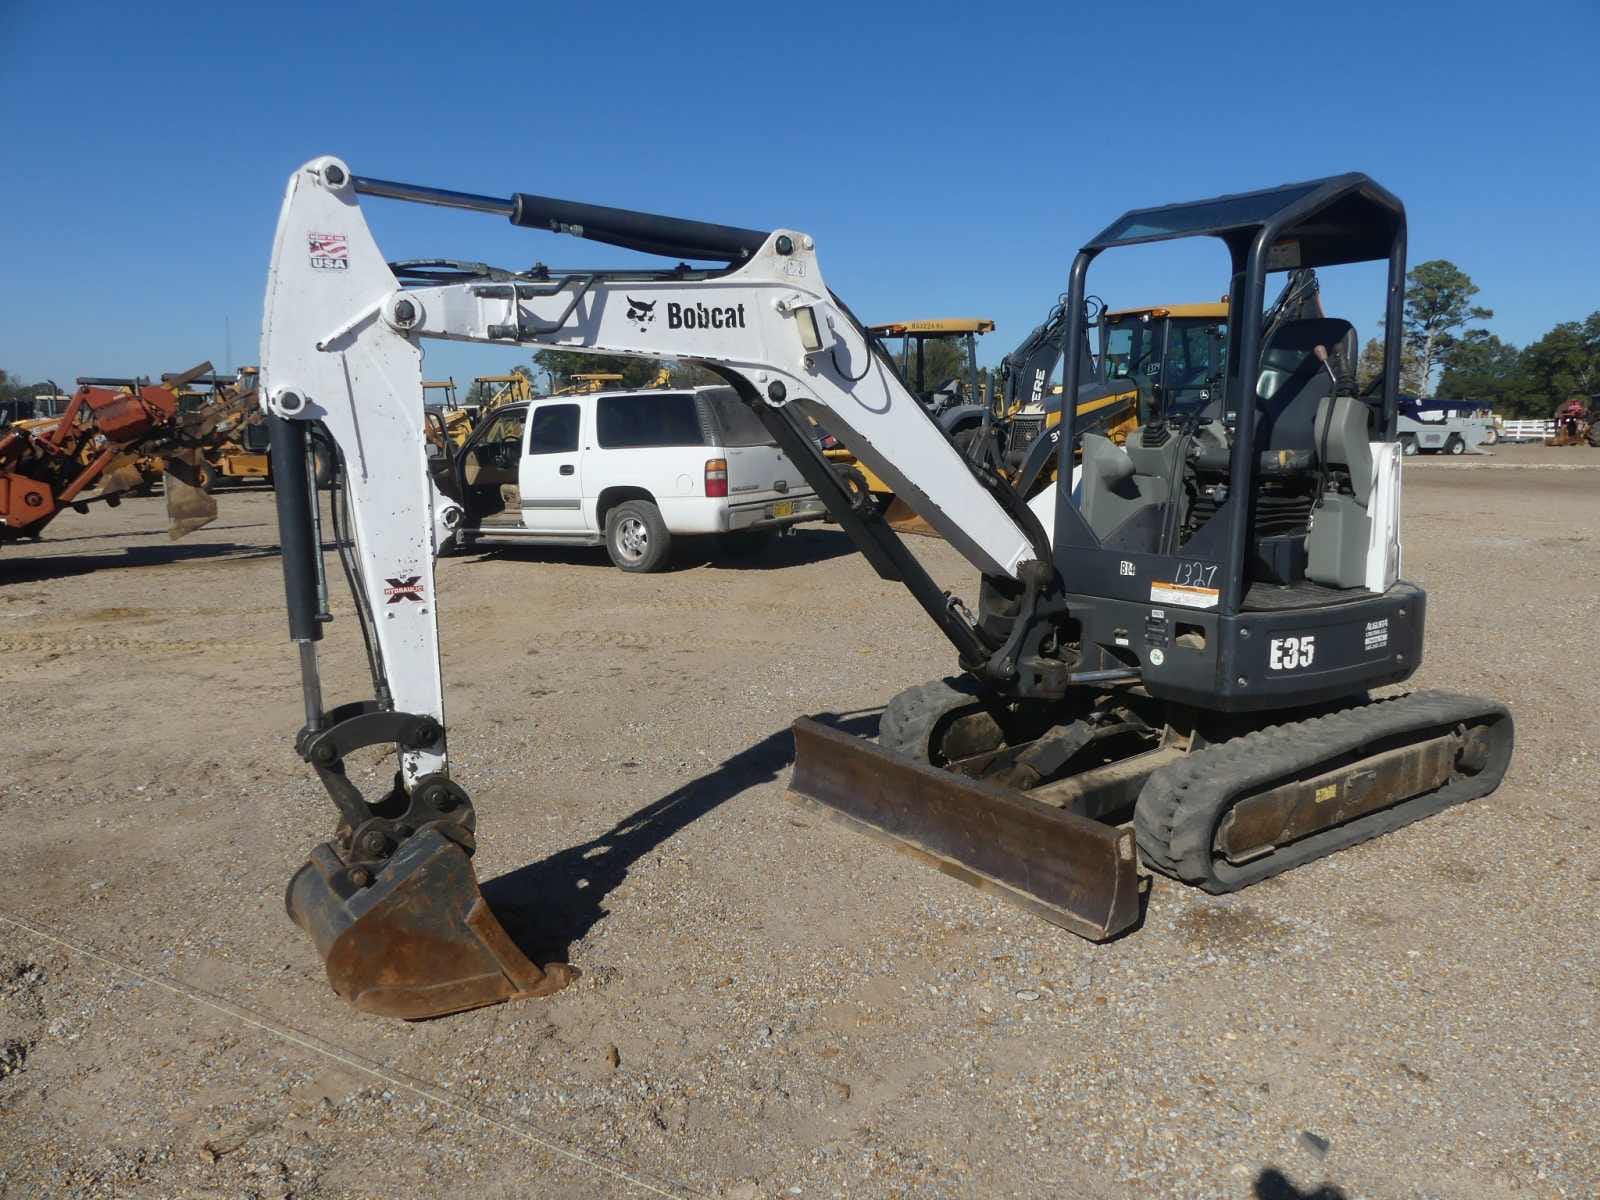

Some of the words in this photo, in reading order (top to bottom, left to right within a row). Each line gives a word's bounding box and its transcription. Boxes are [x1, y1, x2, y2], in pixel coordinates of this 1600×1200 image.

[312, 258, 347, 269] USA
[667, 302, 746, 329] Bobcat
[1175, 562, 1218, 588] 1327
[1270, 636, 1315, 669] E35
